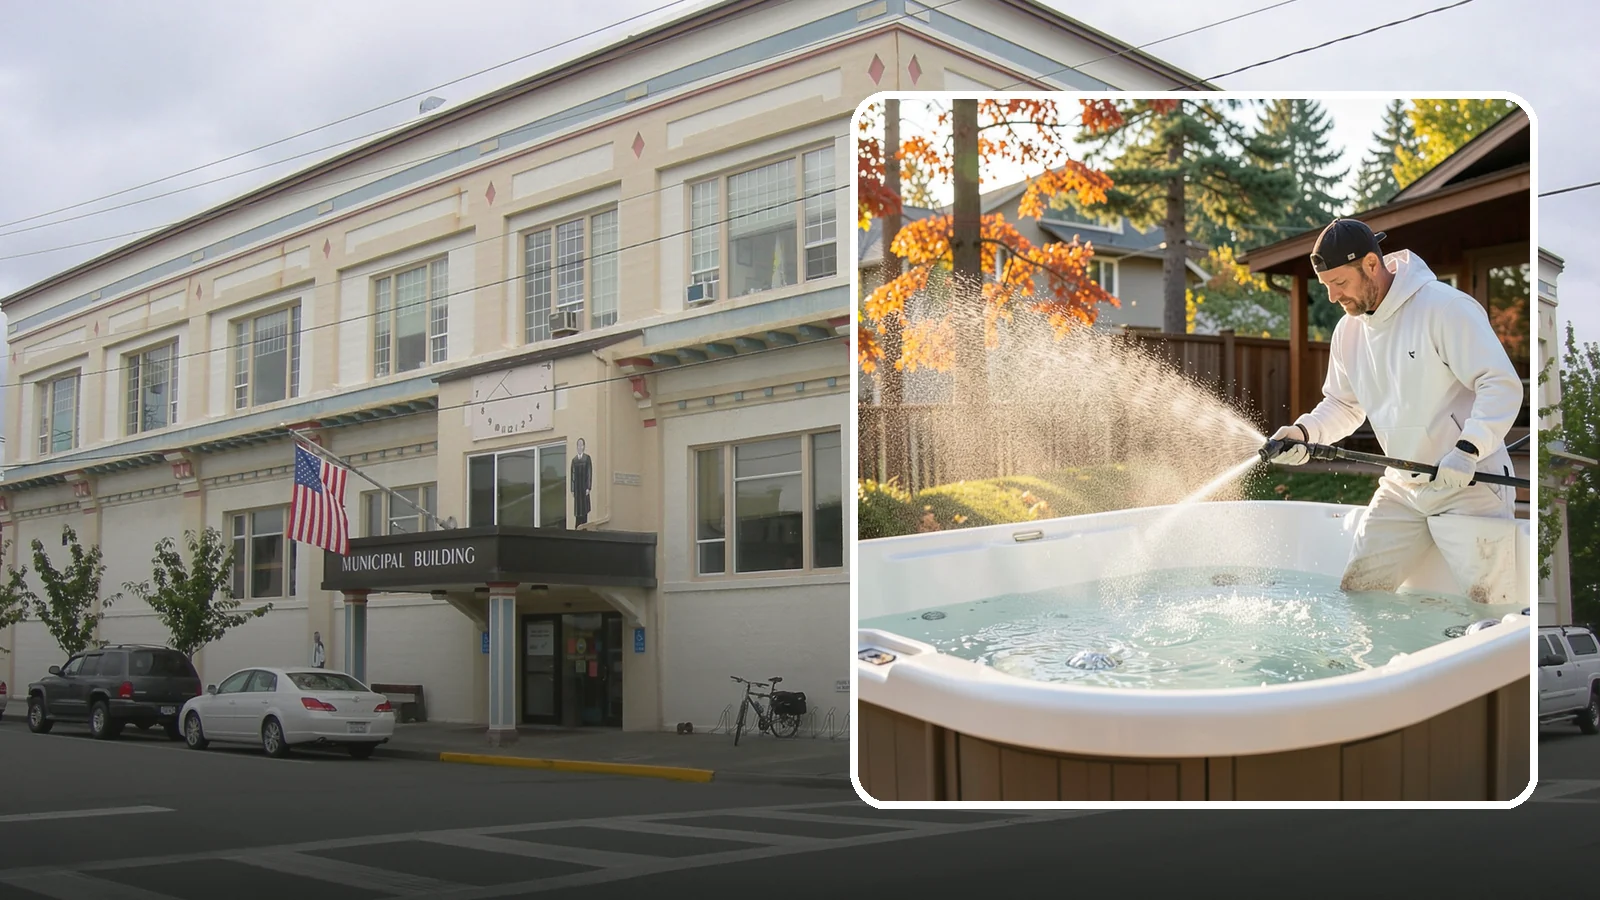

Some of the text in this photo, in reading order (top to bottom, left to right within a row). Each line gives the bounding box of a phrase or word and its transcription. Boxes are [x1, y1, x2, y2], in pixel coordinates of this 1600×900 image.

[476, 390, 479, 398] 7
[481, 407, 485, 415] 8
[488, 417, 492, 426] 9
[495, 423, 500, 431] 10
[507, 425, 513, 433] 12
[515, 424, 518, 432] 1
[521, 420, 526, 428] 2
[529, 414, 533, 422] 3
[536, 402, 540, 410] 4
[547, 362, 552, 370] 6
[342, 546, 475, 572] MUNICIPAL BUILDING
